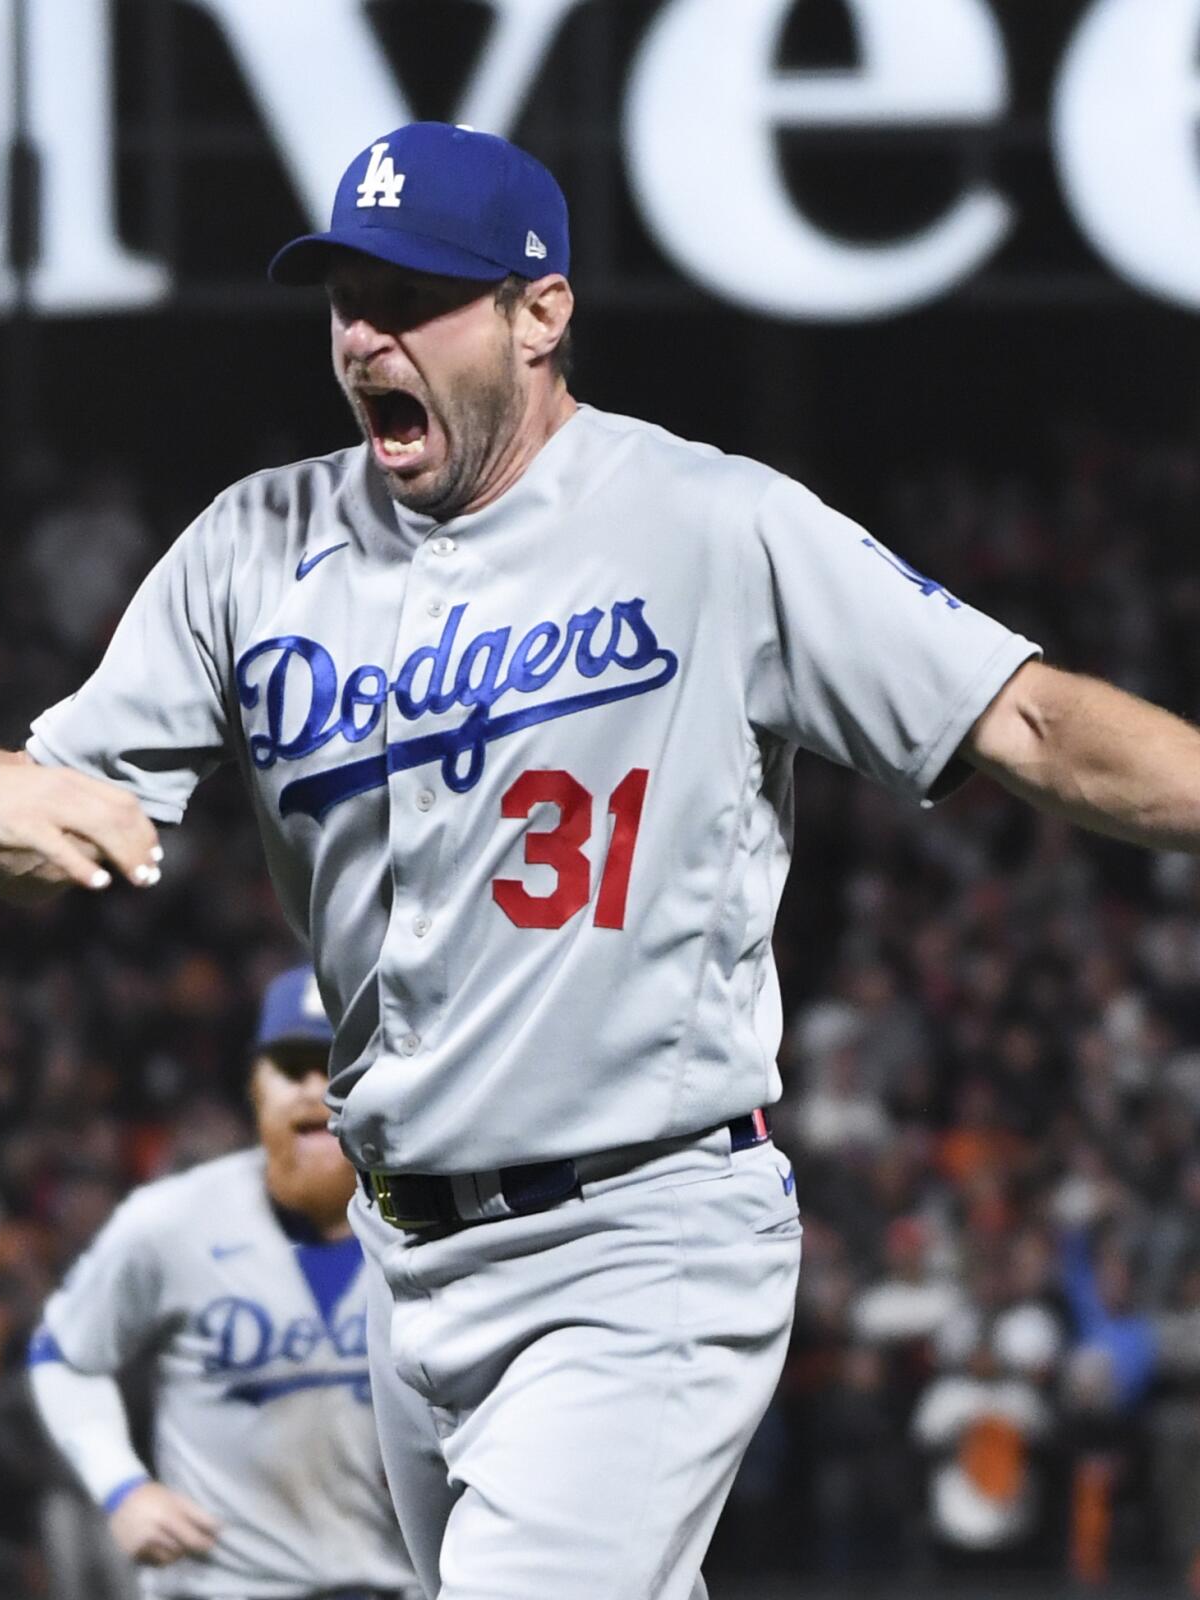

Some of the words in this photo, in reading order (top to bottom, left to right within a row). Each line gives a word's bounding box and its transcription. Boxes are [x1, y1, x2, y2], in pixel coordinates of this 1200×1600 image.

[356, 143, 405, 208] LA
[236, 598, 677, 793] Dodgers
[492, 767, 649, 929] 31
